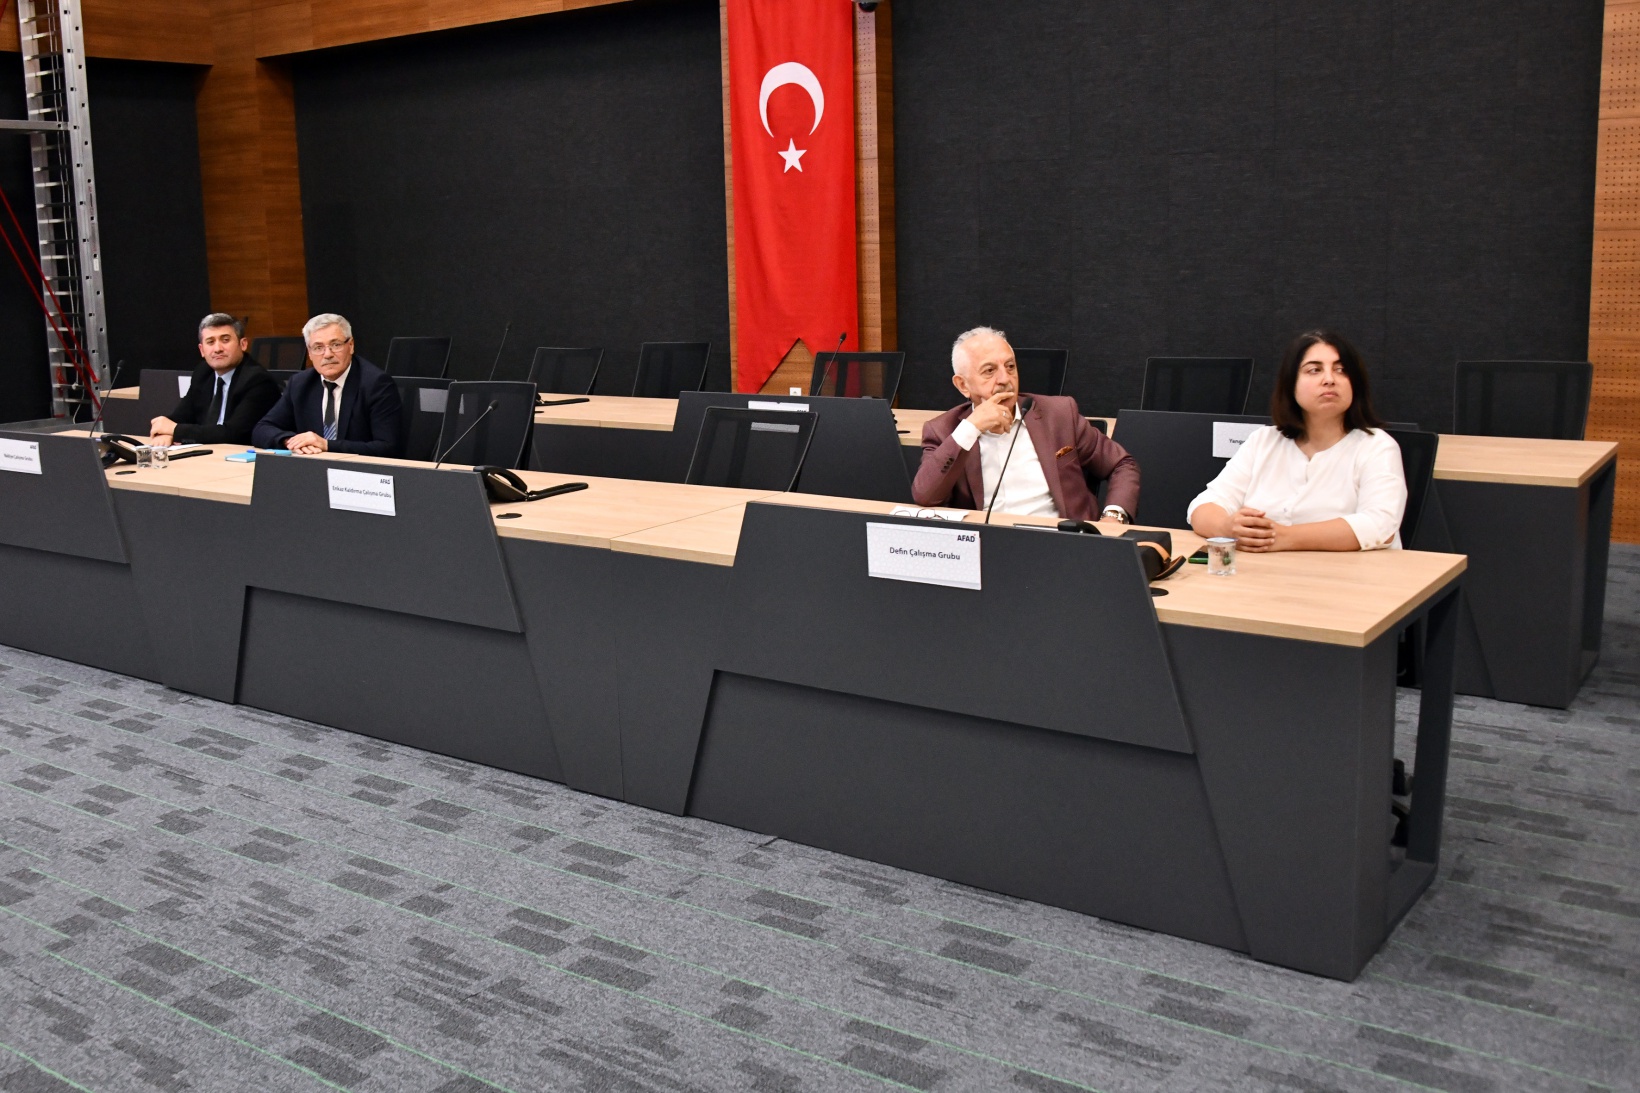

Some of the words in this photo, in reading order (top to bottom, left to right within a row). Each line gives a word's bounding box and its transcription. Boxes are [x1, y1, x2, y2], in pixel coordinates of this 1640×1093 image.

[957, 534, 976, 543] AFAD
[889, 546, 908, 555] Defin
[909, 548, 937, 558] Çalışma
[938, 551, 961, 560] Grubu
